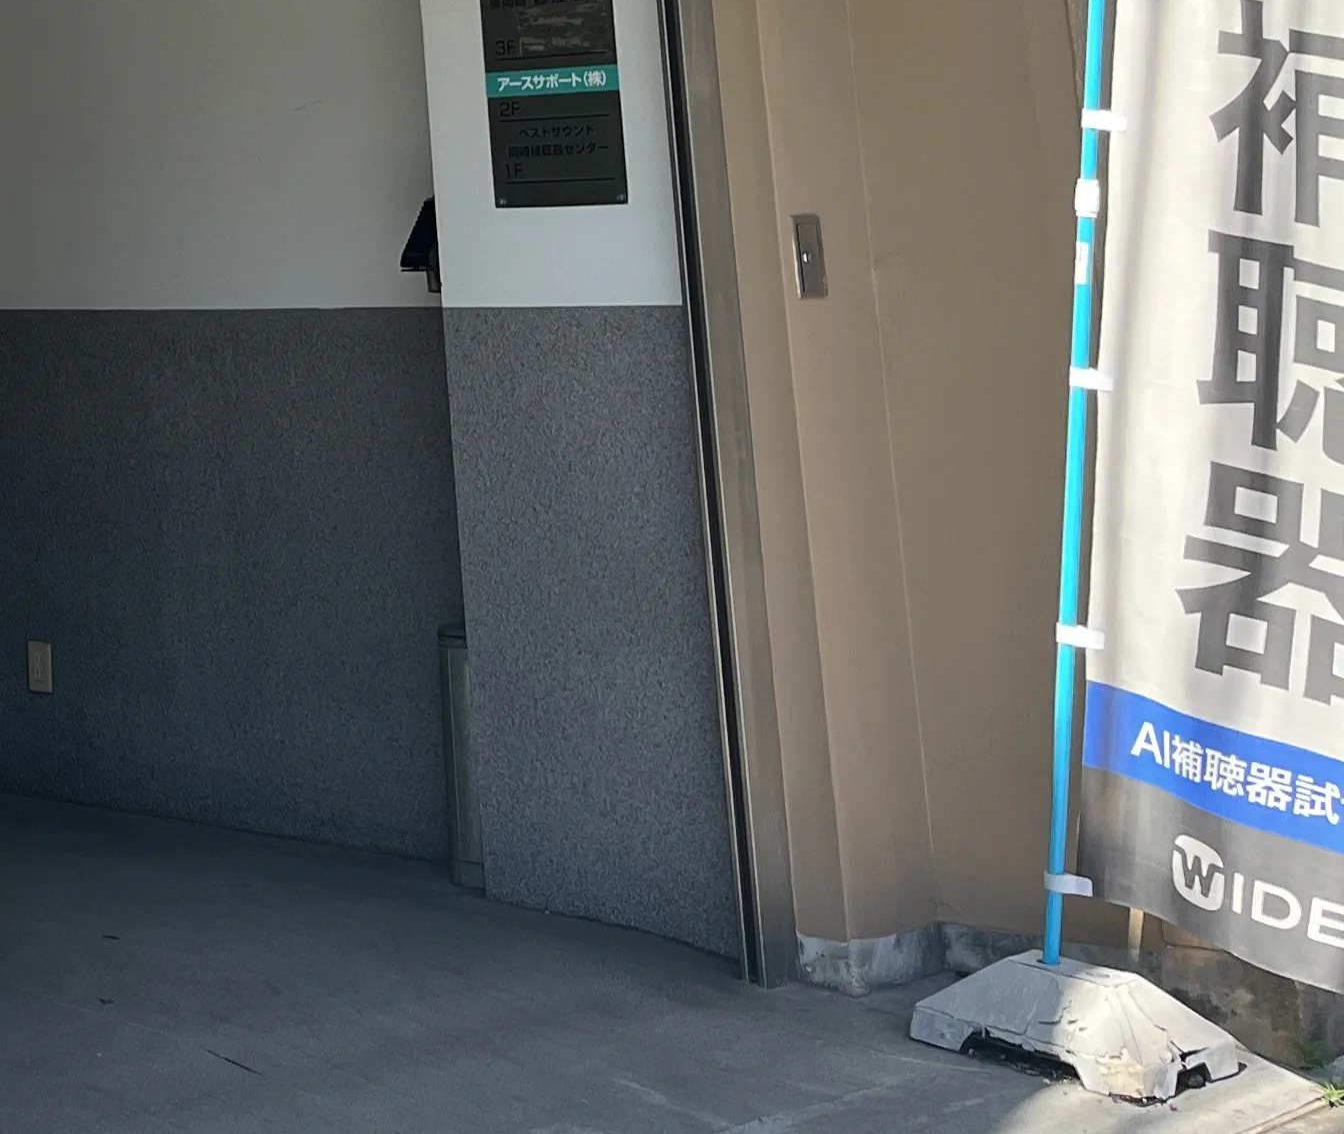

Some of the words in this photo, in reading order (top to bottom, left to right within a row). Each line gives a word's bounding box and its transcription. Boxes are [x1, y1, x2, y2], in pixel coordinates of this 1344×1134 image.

[495, 39, 517, 56] 3F
[499, 101, 521, 117] 2F
[505, 163, 523, 179] 1F
[1130, 721, 1344, 825] AI補聴器試
